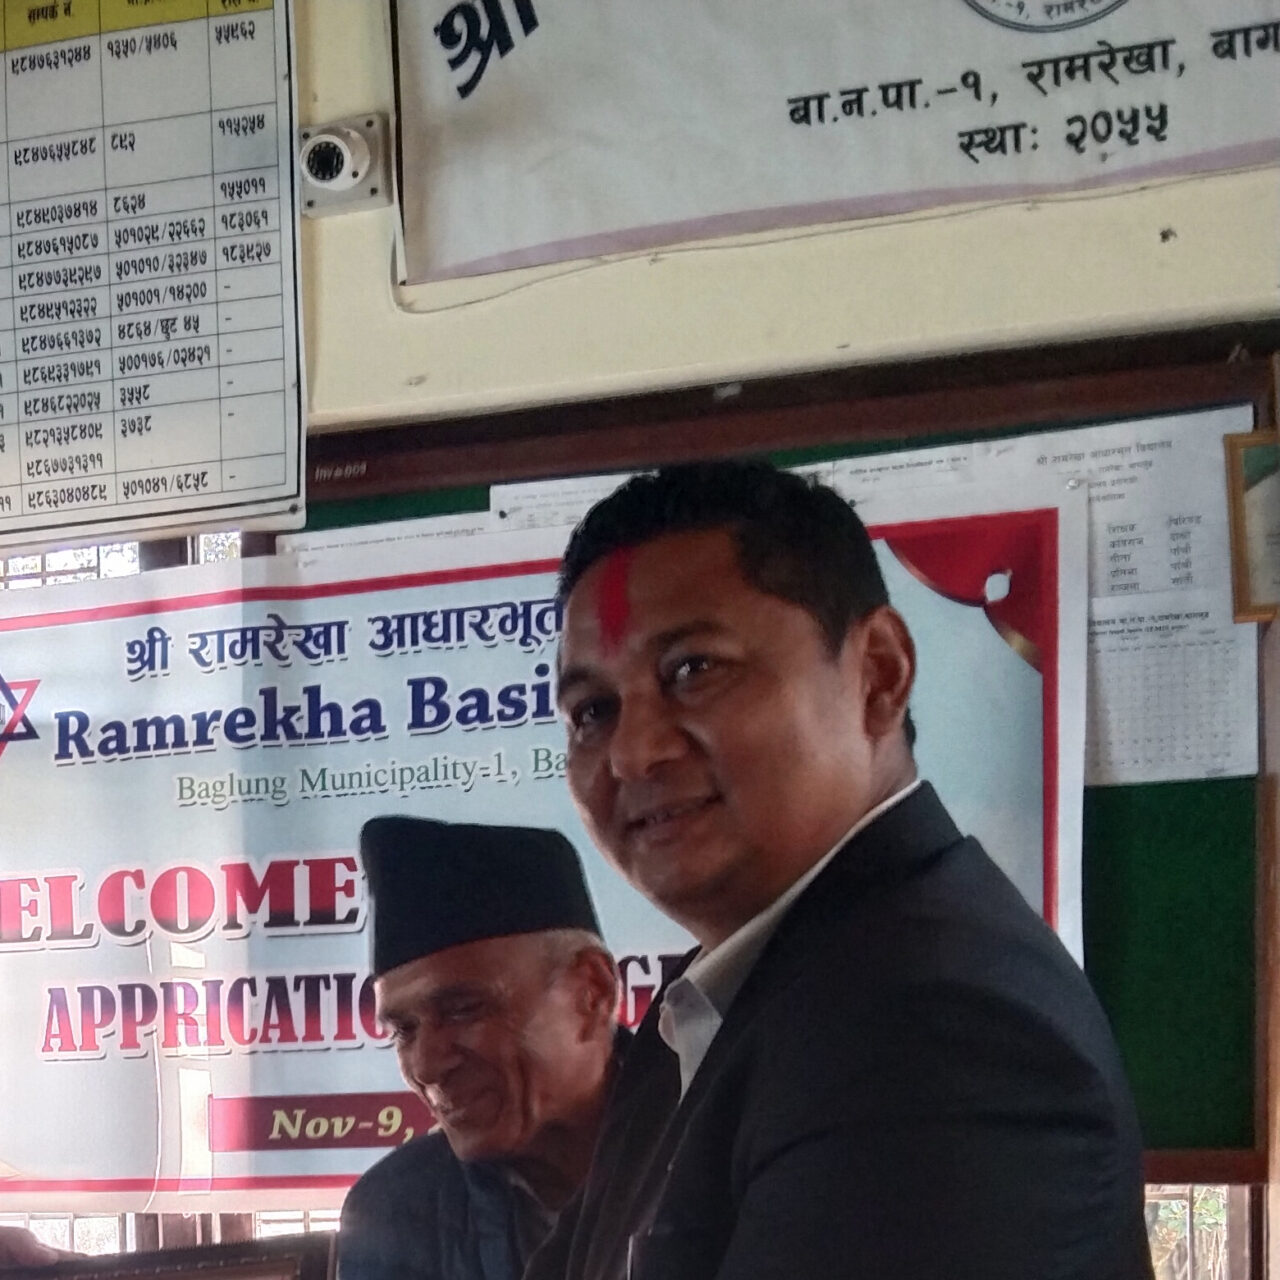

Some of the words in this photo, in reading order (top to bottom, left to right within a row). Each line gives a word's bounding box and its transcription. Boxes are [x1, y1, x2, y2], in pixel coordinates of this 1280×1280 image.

[1023, 39, 1186, 96] रामरेखा,
[1210, 21, 1280, 61] बाग
[1066, 102, 1169, 154] २०५५
[125, 626, 172, 673] श्री
[188, 614, 349, 664] रामरेखा
[53, 684, 385, 760] Ramrekha
[407, 663, 555, 729] Basi
[177, 773, 287, 803] Baglung
[300, 753, 518, 792] Municipality-1,
[531, 747, 566, 776] Ba
[42, 973, 390, 1054] APPRICATIO
[268, 1106, 415, 1143] Nov-9,
